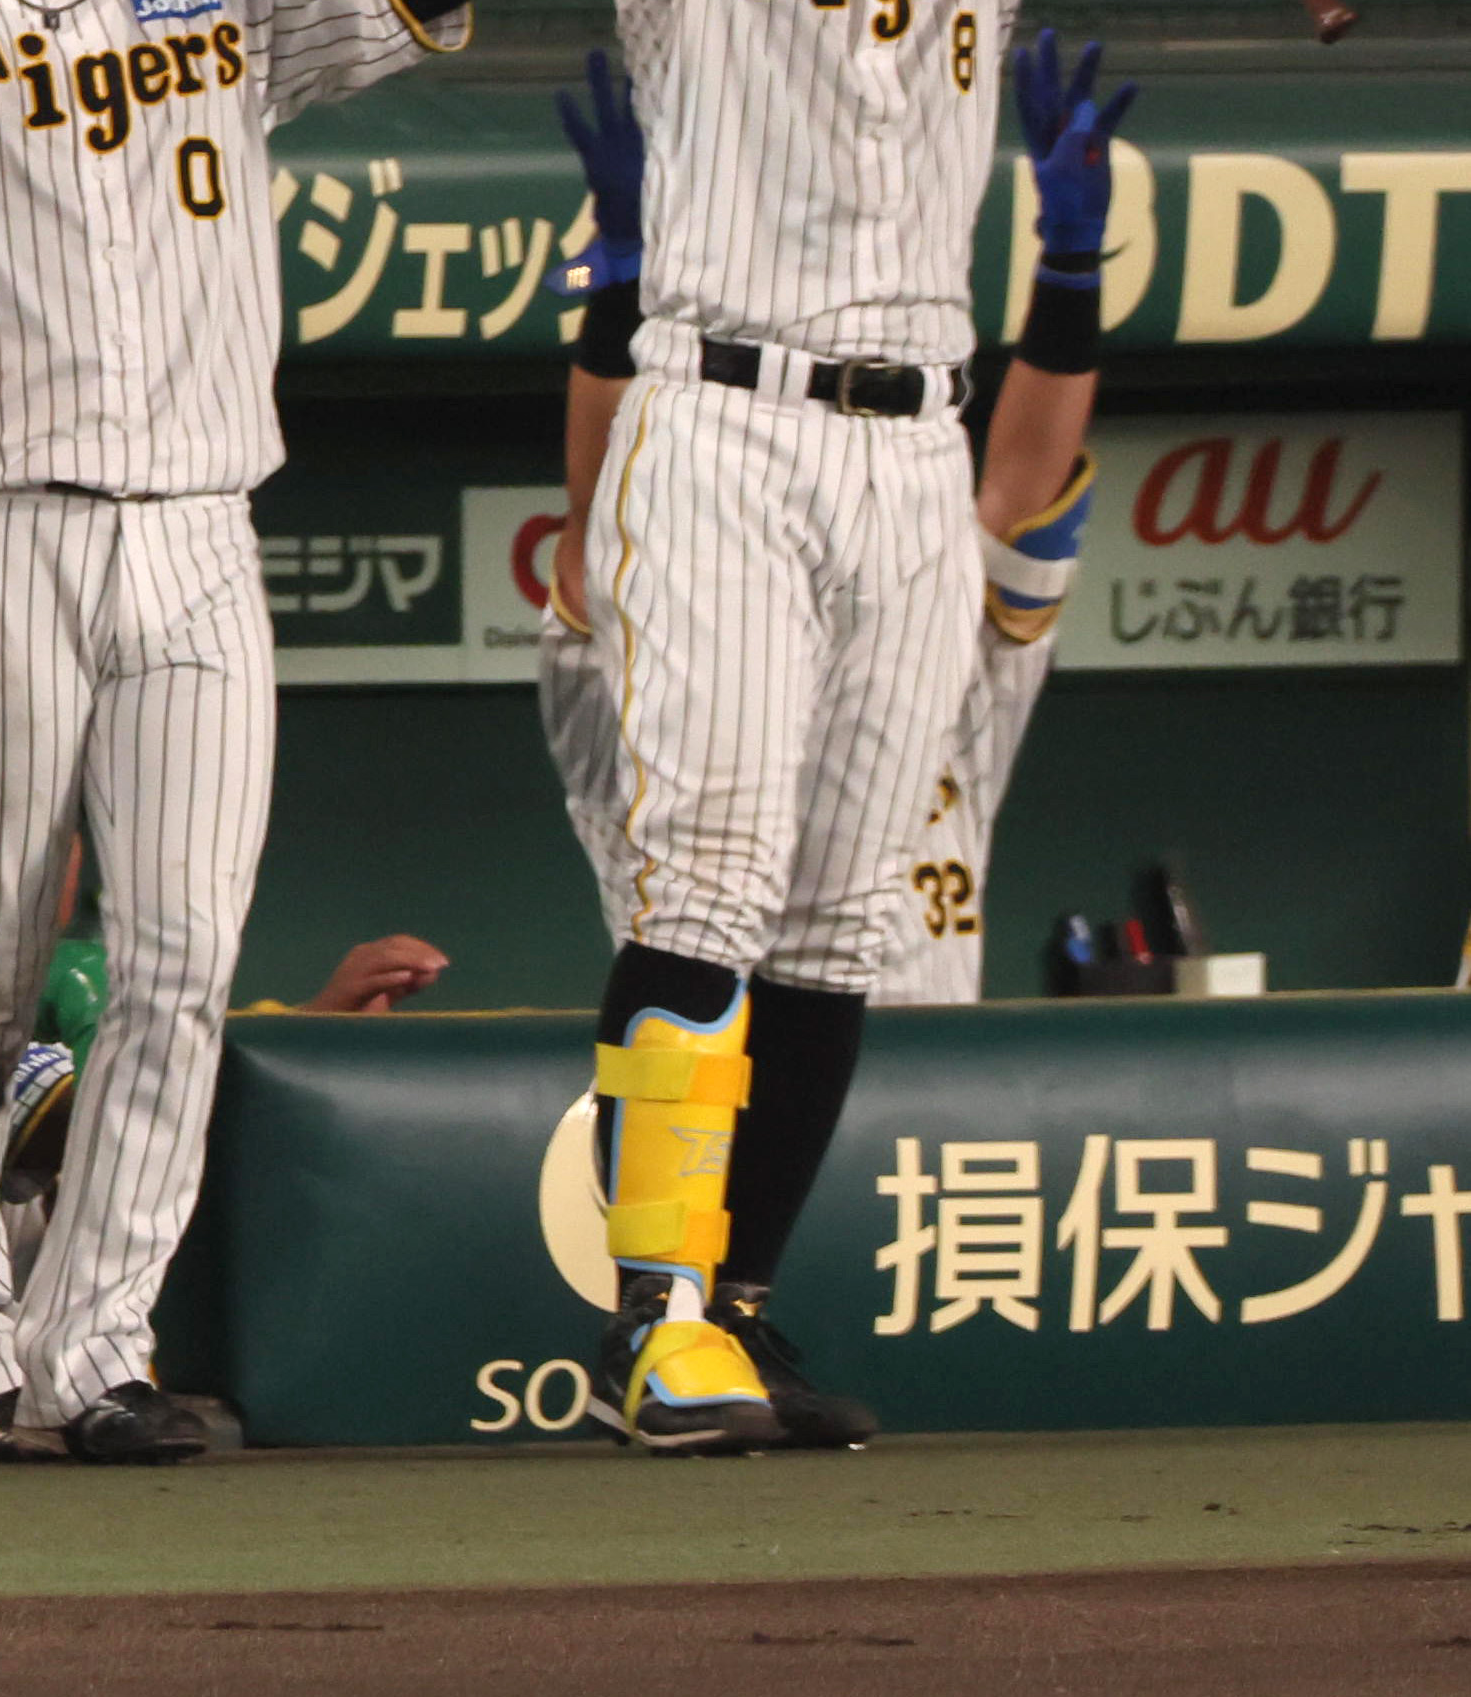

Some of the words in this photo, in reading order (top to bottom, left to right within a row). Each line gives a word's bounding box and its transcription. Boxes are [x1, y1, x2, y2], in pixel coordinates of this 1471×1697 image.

[950, 11, 977, 94] 8
[174, 134, 226, 221] 0
[274, 158, 598, 344] ジェッ
[1132, 436, 1382, 547] au
[1109, 575, 1406, 643] じぶん銀行
